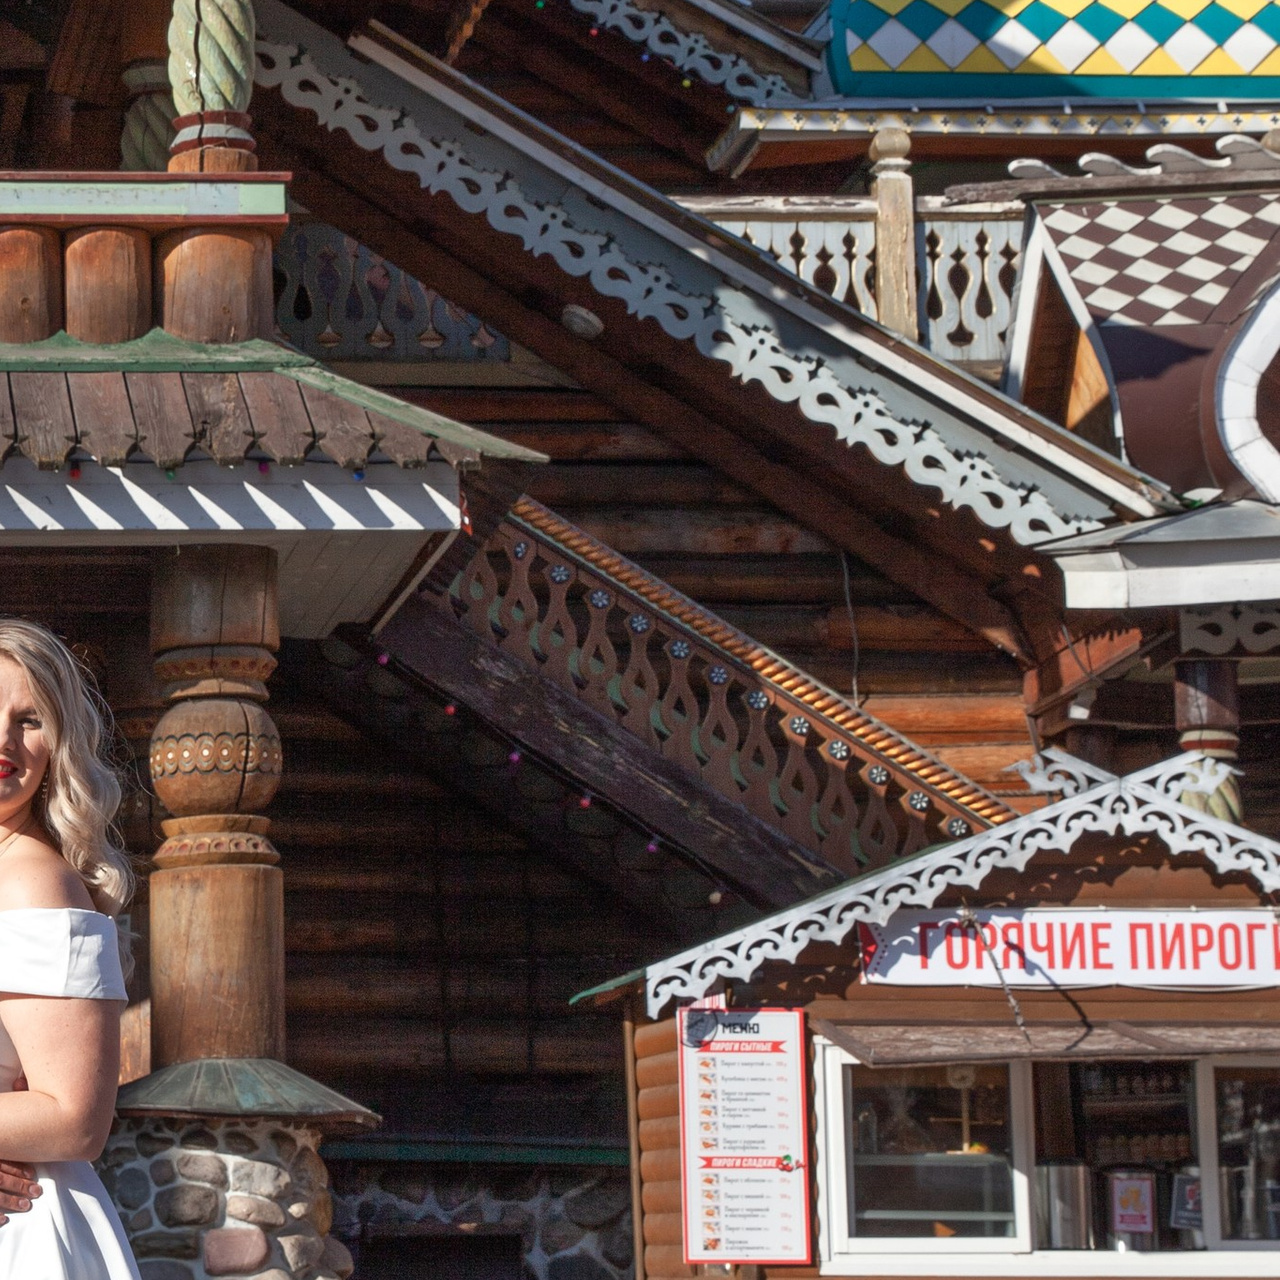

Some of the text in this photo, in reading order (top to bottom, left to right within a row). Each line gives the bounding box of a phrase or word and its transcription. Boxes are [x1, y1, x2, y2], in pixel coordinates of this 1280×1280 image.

[920, 922, 1280, 970] ГОРЯЧИЕ ПИРОГ
[722, 1023, 760, 1034] МЕНЮ
